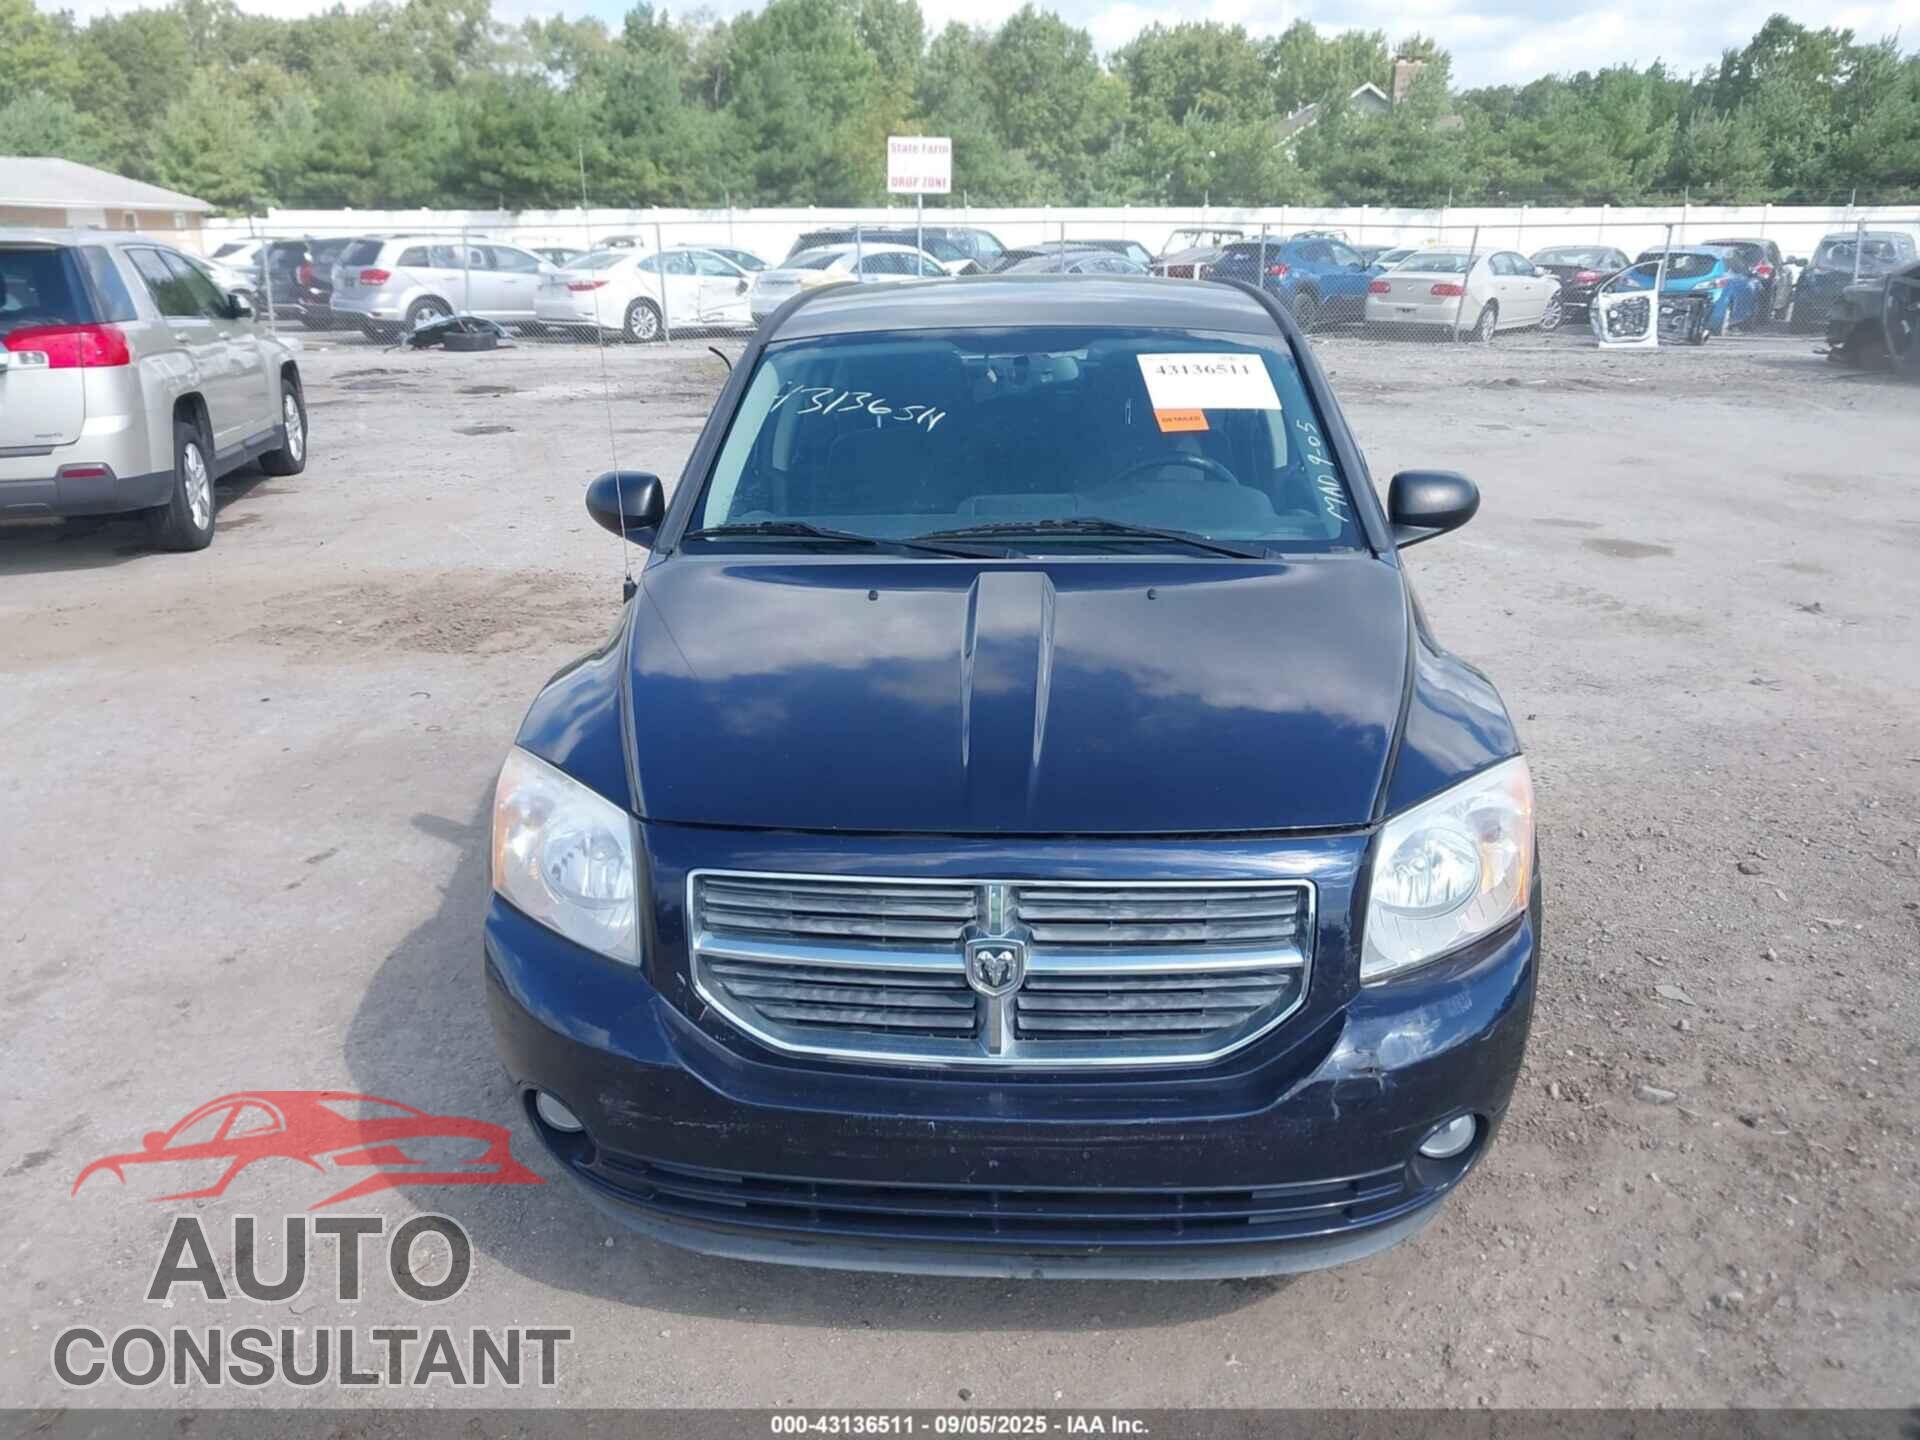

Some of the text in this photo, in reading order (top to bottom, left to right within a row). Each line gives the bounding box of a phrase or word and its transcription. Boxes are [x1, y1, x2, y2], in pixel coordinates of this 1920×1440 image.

[891, 143, 919, 154] State
[891, 176, 946, 188] DROP ZONE
[1155, 364, 1251, 376] 43136511
